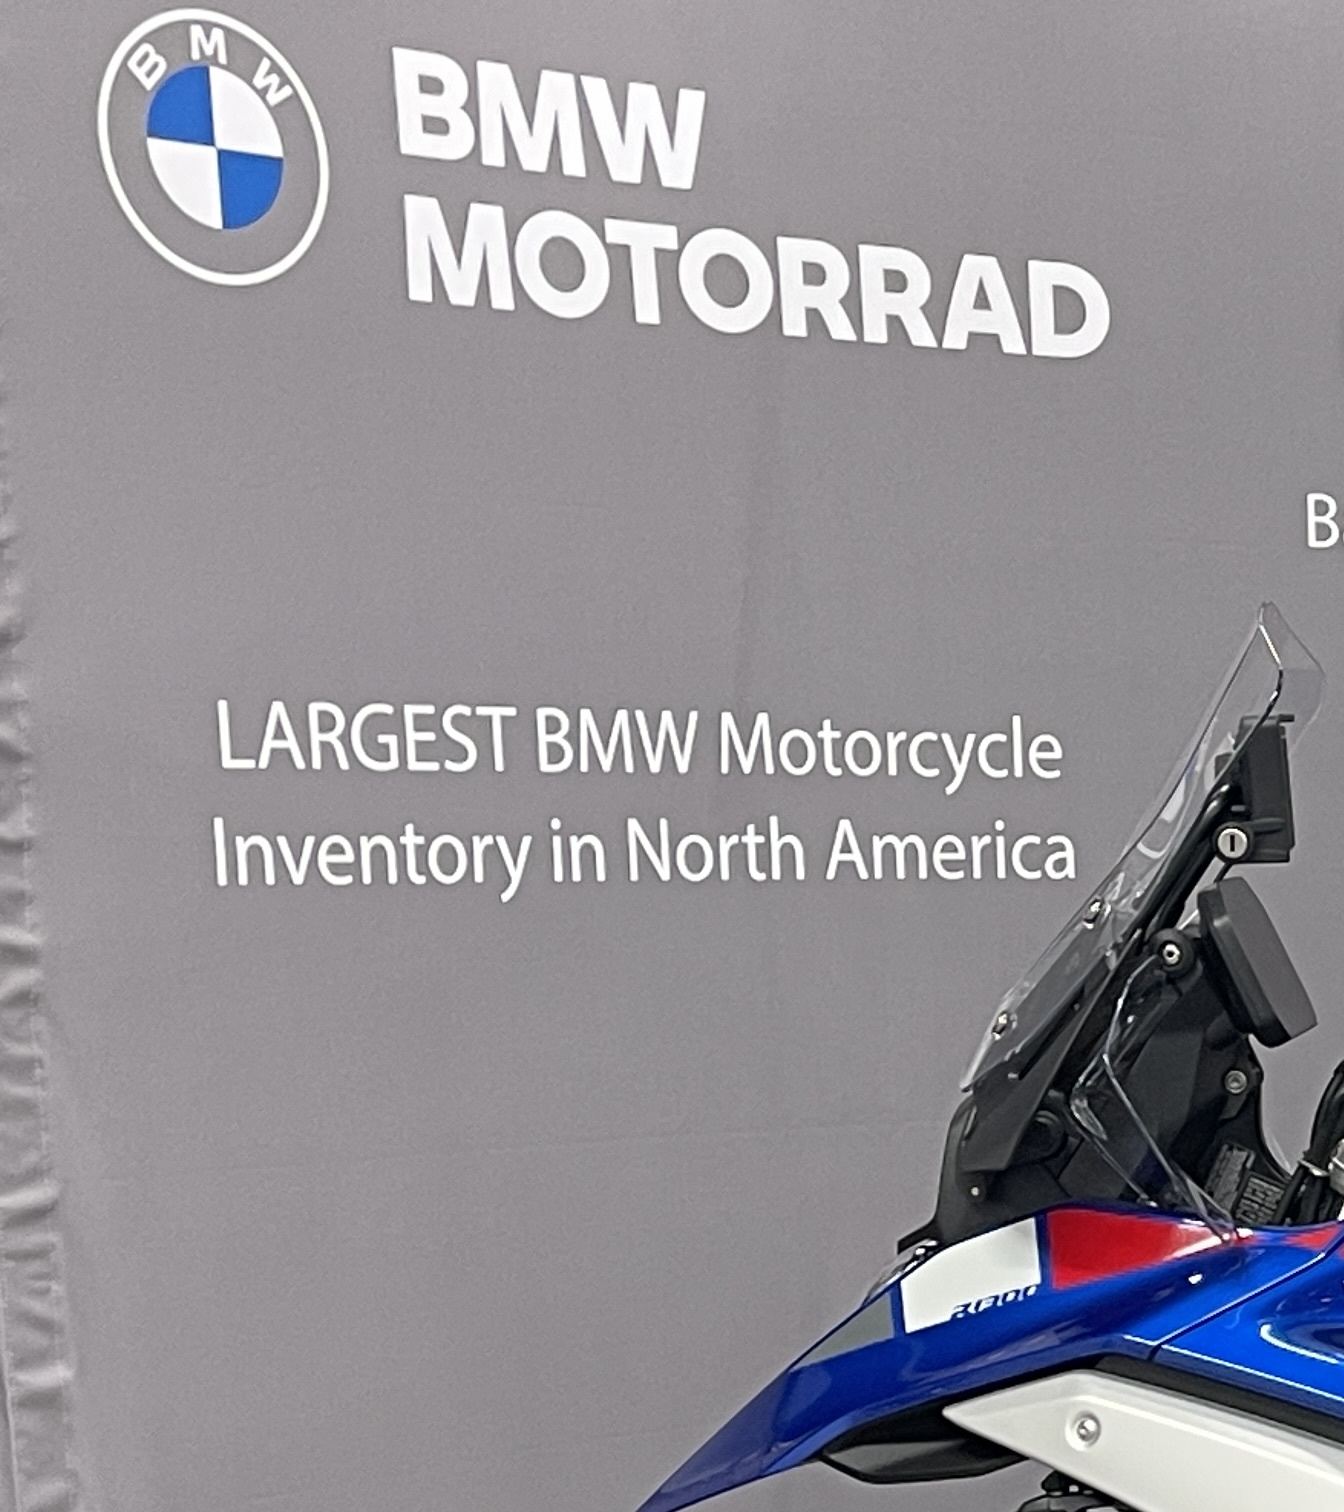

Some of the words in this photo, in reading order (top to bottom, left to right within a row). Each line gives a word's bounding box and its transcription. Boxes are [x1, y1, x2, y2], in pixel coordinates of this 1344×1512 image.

[127, 25, 293, 106] BMW
[392, 47, 705, 189] BMW
[404, 194, 1110, 357] MOTORRAD
[217, 700, 517, 772] LARGEST
[536, 706, 698, 773] BMW
[721, 712, 1062, 795] Motorcycle
[214, 817, 532, 902] Inventory
[551, 818, 605, 883] in
[628, 816, 805, 881] North
[826, 819, 1075, 880] America
